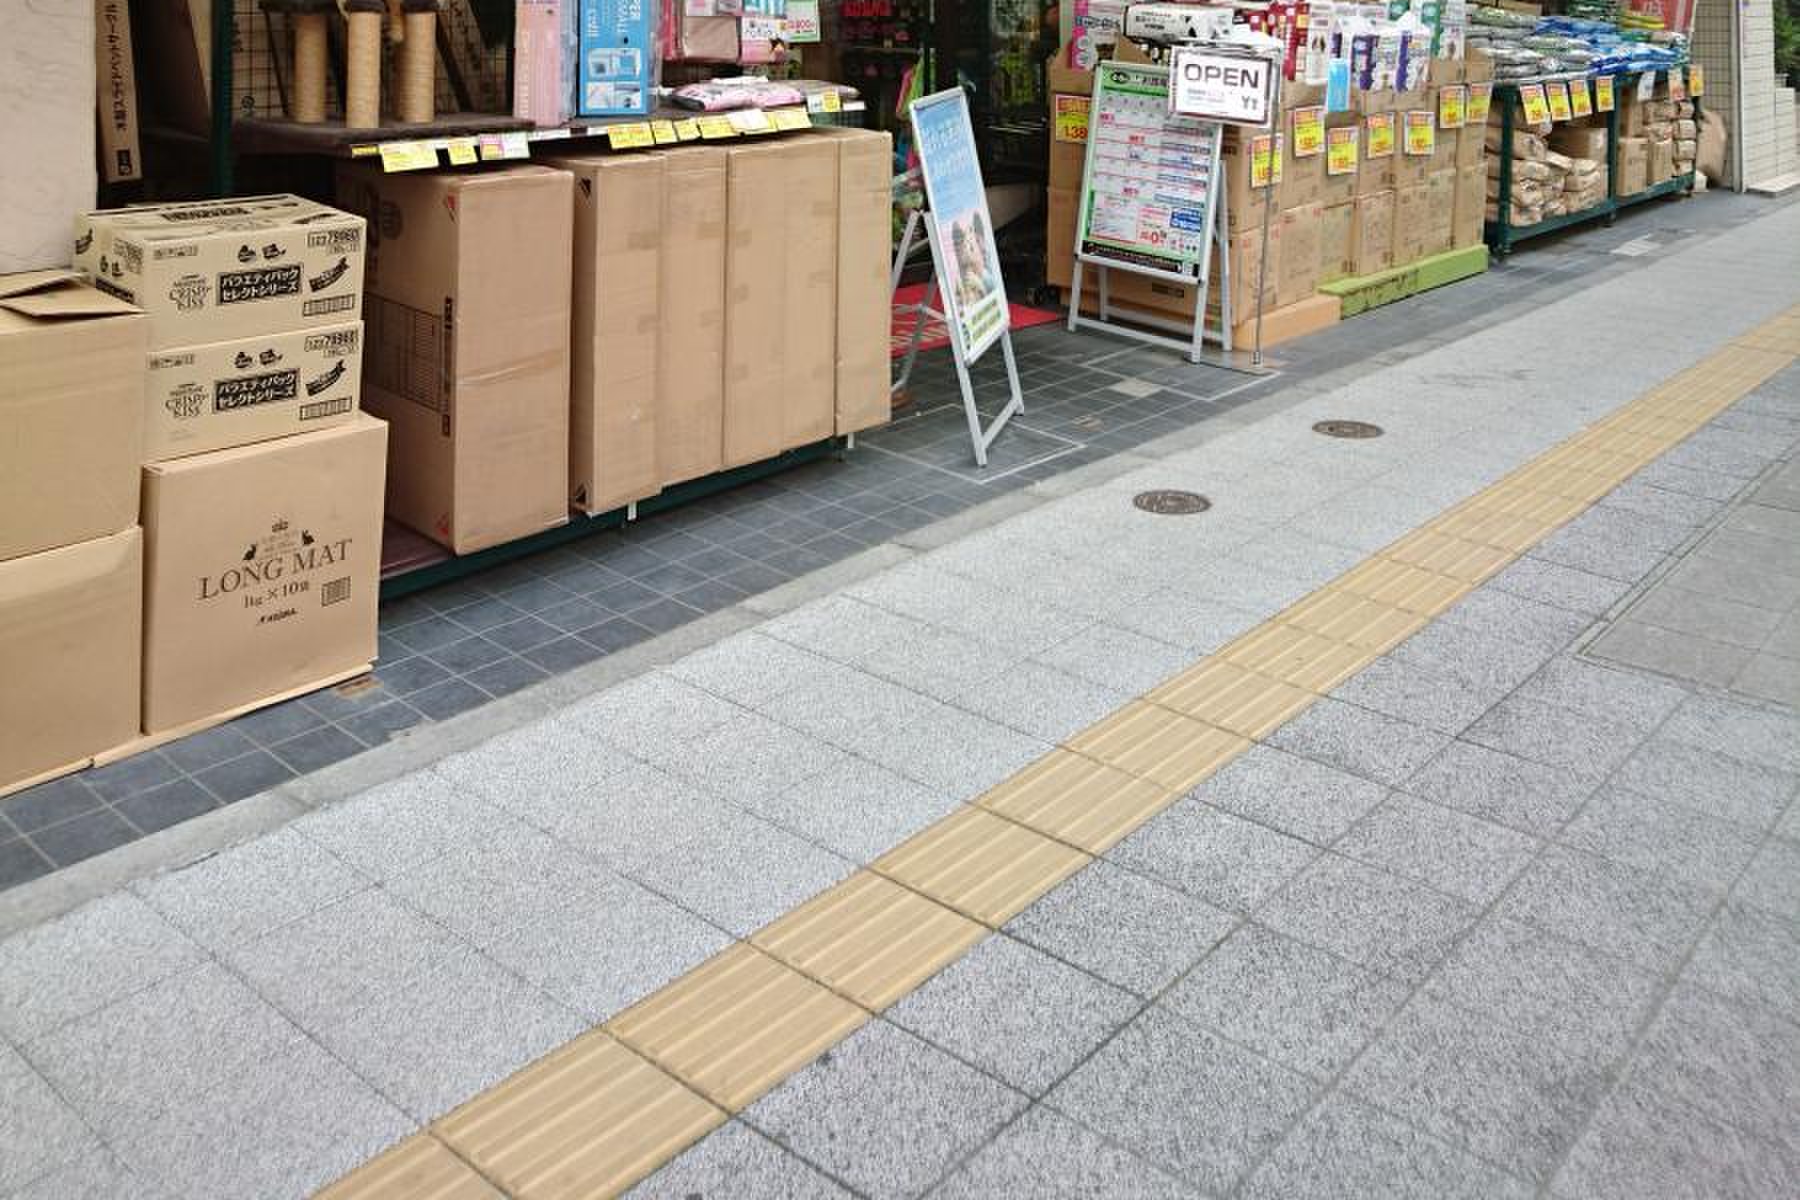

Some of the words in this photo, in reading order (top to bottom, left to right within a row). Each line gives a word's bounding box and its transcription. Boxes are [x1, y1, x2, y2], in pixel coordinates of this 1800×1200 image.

[1184, 63, 1259, 89] OPEN
[199, 557, 284, 600] LONG
[291, 538, 353, 575] MAT
